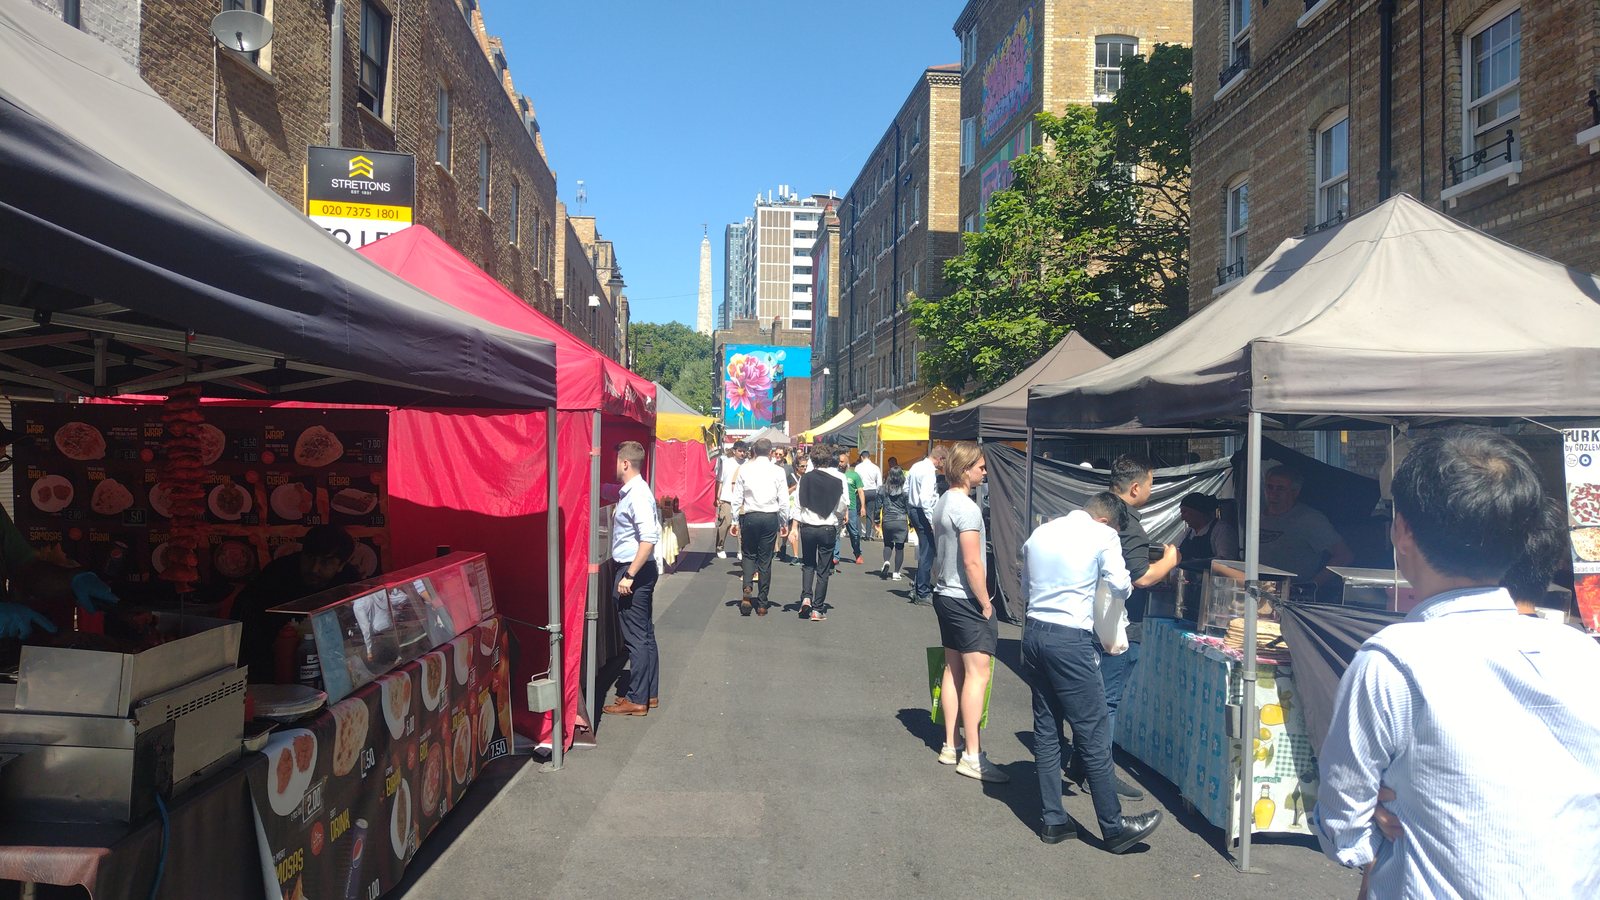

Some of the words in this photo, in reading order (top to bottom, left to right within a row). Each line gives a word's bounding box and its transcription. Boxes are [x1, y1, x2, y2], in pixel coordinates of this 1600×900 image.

[331, 178, 391, 192] STRETTONS
[322, 205, 342, 216] 020
[346, 206, 371, 218] 7375
[377, 208, 399, 220] 1801
[1565, 443, 1573, 452] by
[490, 740, 507, 758] 7.50
[330, 807, 351, 842] DRINK
